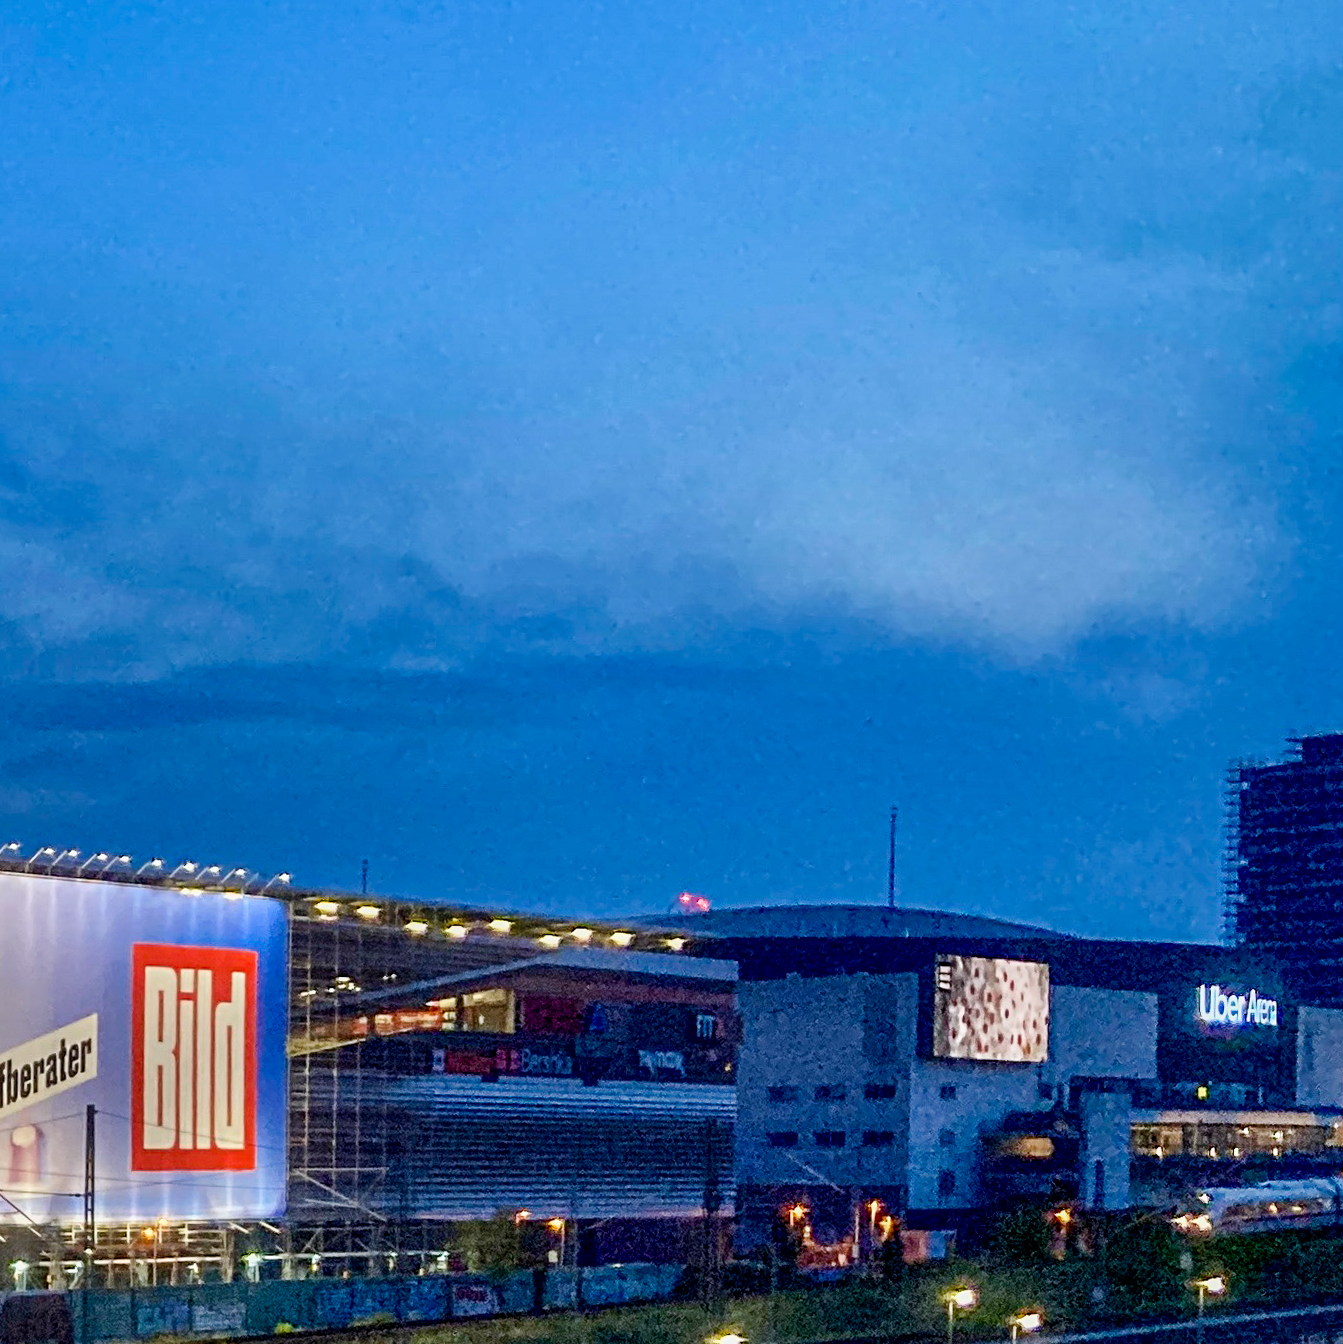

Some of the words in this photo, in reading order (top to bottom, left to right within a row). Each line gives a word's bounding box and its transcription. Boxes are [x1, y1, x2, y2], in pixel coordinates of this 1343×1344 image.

[143, 965, 246, 1150] Bild
[1199, 984, 1246, 1022] Uber
[1246, 988, 1277, 1026] Arena
